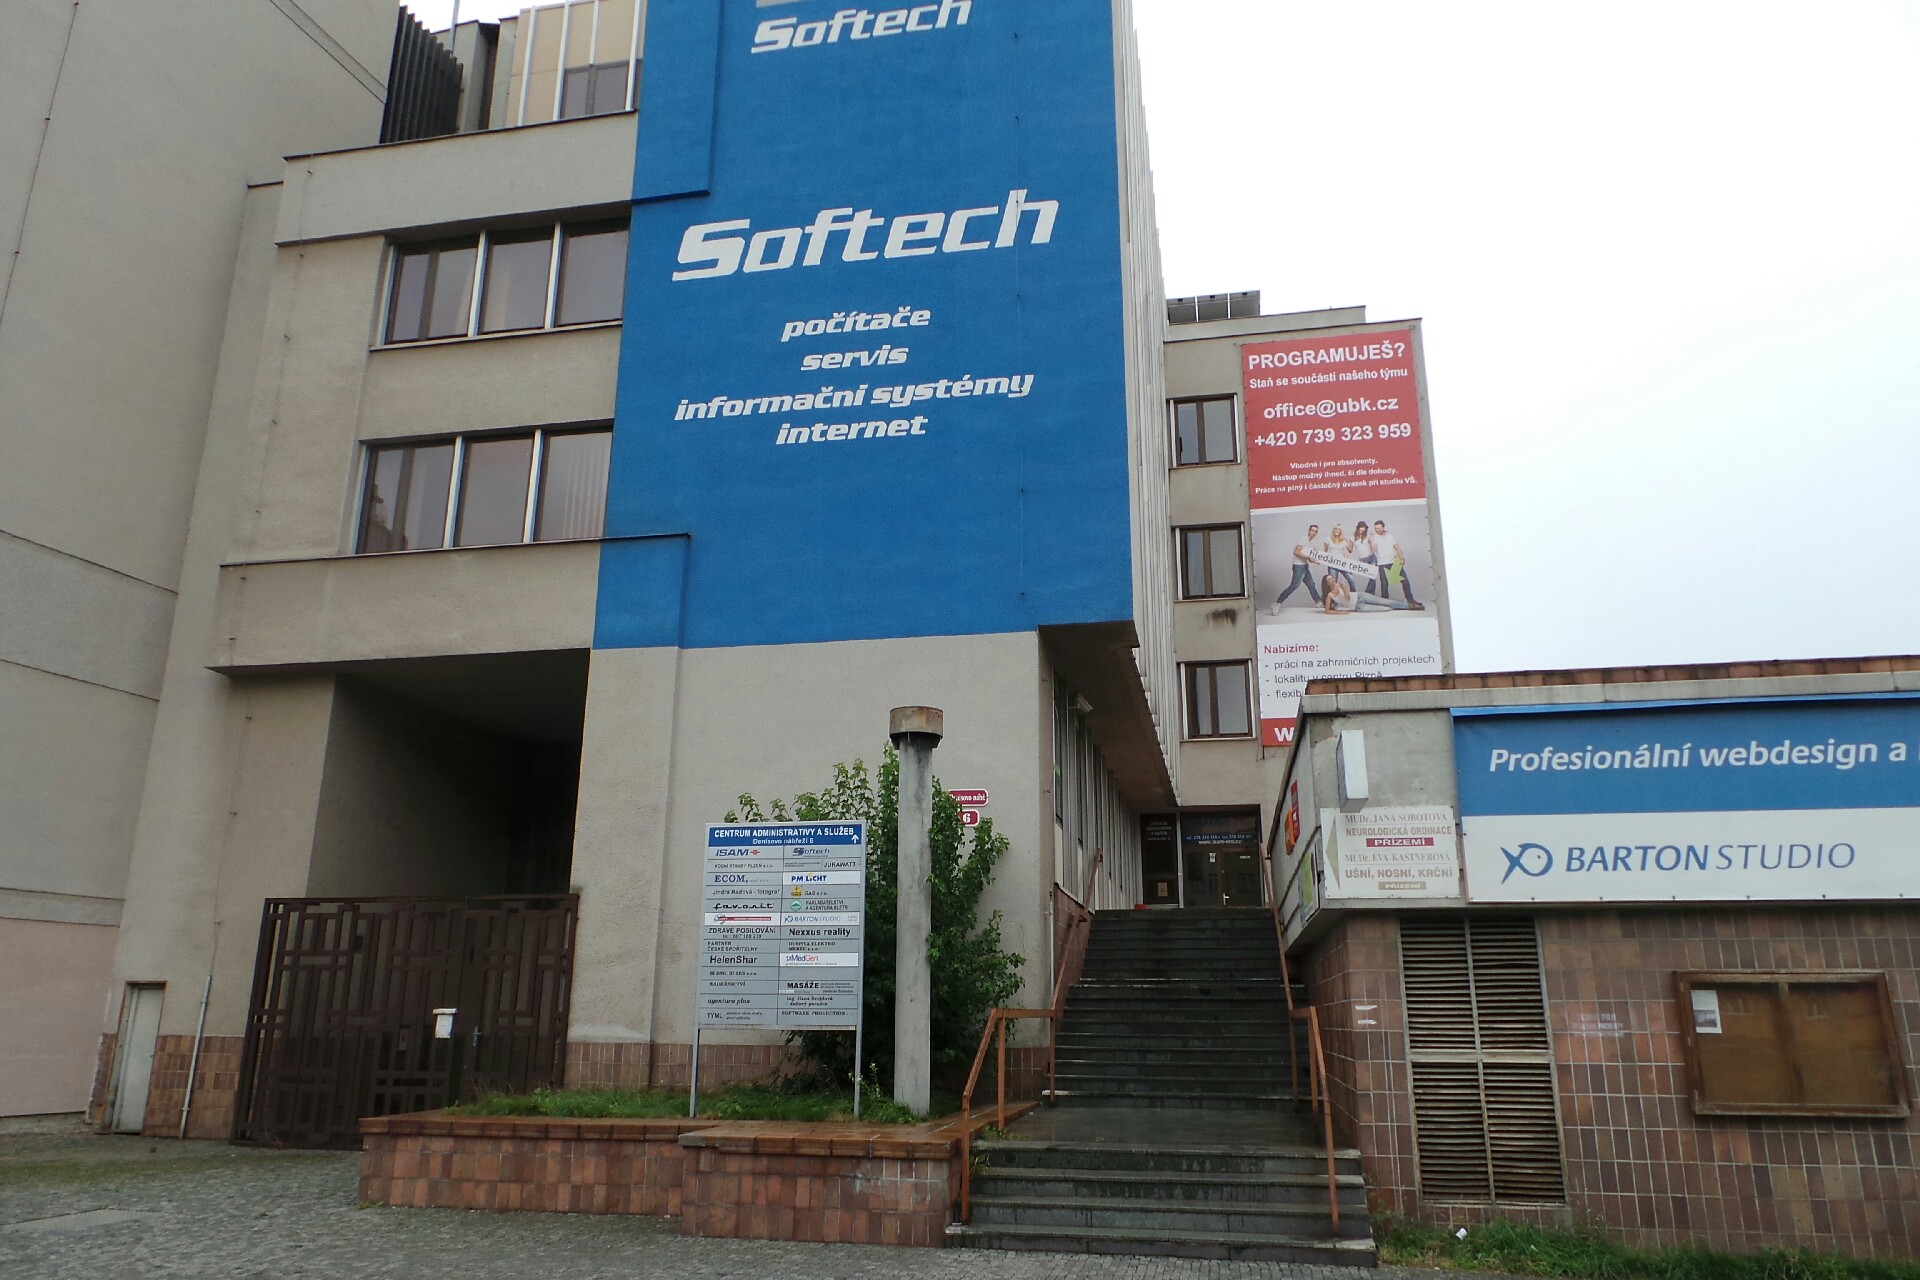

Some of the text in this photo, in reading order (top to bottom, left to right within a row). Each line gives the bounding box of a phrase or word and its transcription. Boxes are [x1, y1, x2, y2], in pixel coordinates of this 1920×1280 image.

[751, 0, 972, 53] Softech
[672, 189, 1059, 281] Softech
[781, 306, 931, 342] počítače
[801, 345, 908, 371] servis
[1249, 340, 1405, 369] PROGRAMUJEŠ?
[1250, 379, 1273, 388] Staň
[1276, 378, 1288, 386] se
[1340, 370, 1377, 381] našeho
[1380, 368, 1408, 380] týmu
[674, 374, 1034, 420] informační systémy
[1264, 397, 1398, 419] office@ubk.cz
[776, 416, 928, 445] internet
[1255, 423, 1411, 447] +420 739 323 959
[1272, 474, 1297, 482] Nástup
[1299, 471, 1323, 480] možný
[1256, 486, 1275, 494] Práce
[1287, 484, 1302, 493] plný
[1309, 481, 1341, 490] částečný
[1343, 479, 1367, 488] úvazek
[1309, 550, 1347, 568] hledáme
[1264, 644, 1319, 654] Nabízíme:
[1274, 660, 1298, 670] práci
[1317, 656, 1379, 667] zahraničních
[1382, 655, 1434, 667] projektech
[1275, 674, 1309, 684] lokalitu
[1276, 689, 1303, 698] flexib
[1490, 738, 1907, 772] Profesionální webdesign a
[963, 813, 970, 823] 6
[1345, 812, 1447, 823] MUDr. JANA SOBOTOVÁ
[715, 829, 750, 837] CENTRUM
[753, 828, 815, 837] ADMINISTRATIVY
[824, 826, 854, 835] SLUŽEB
[1346, 824, 1452, 836] NEUROLOGICKÁ ORDINACE
[1375, 836, 1425, 846] PŘÍZEMÍ
[793, 848, 830, 856] Softech
[1345, 851, 1450, 862] MUDr. EVA KASTNEROVÁ
[1345, 866, 1453, 879] UŠNÍ, NOSNÍ, KRČNÍ
[824, 928, 850, 937] reality
[710, 955, 757, 963] HelenShar
